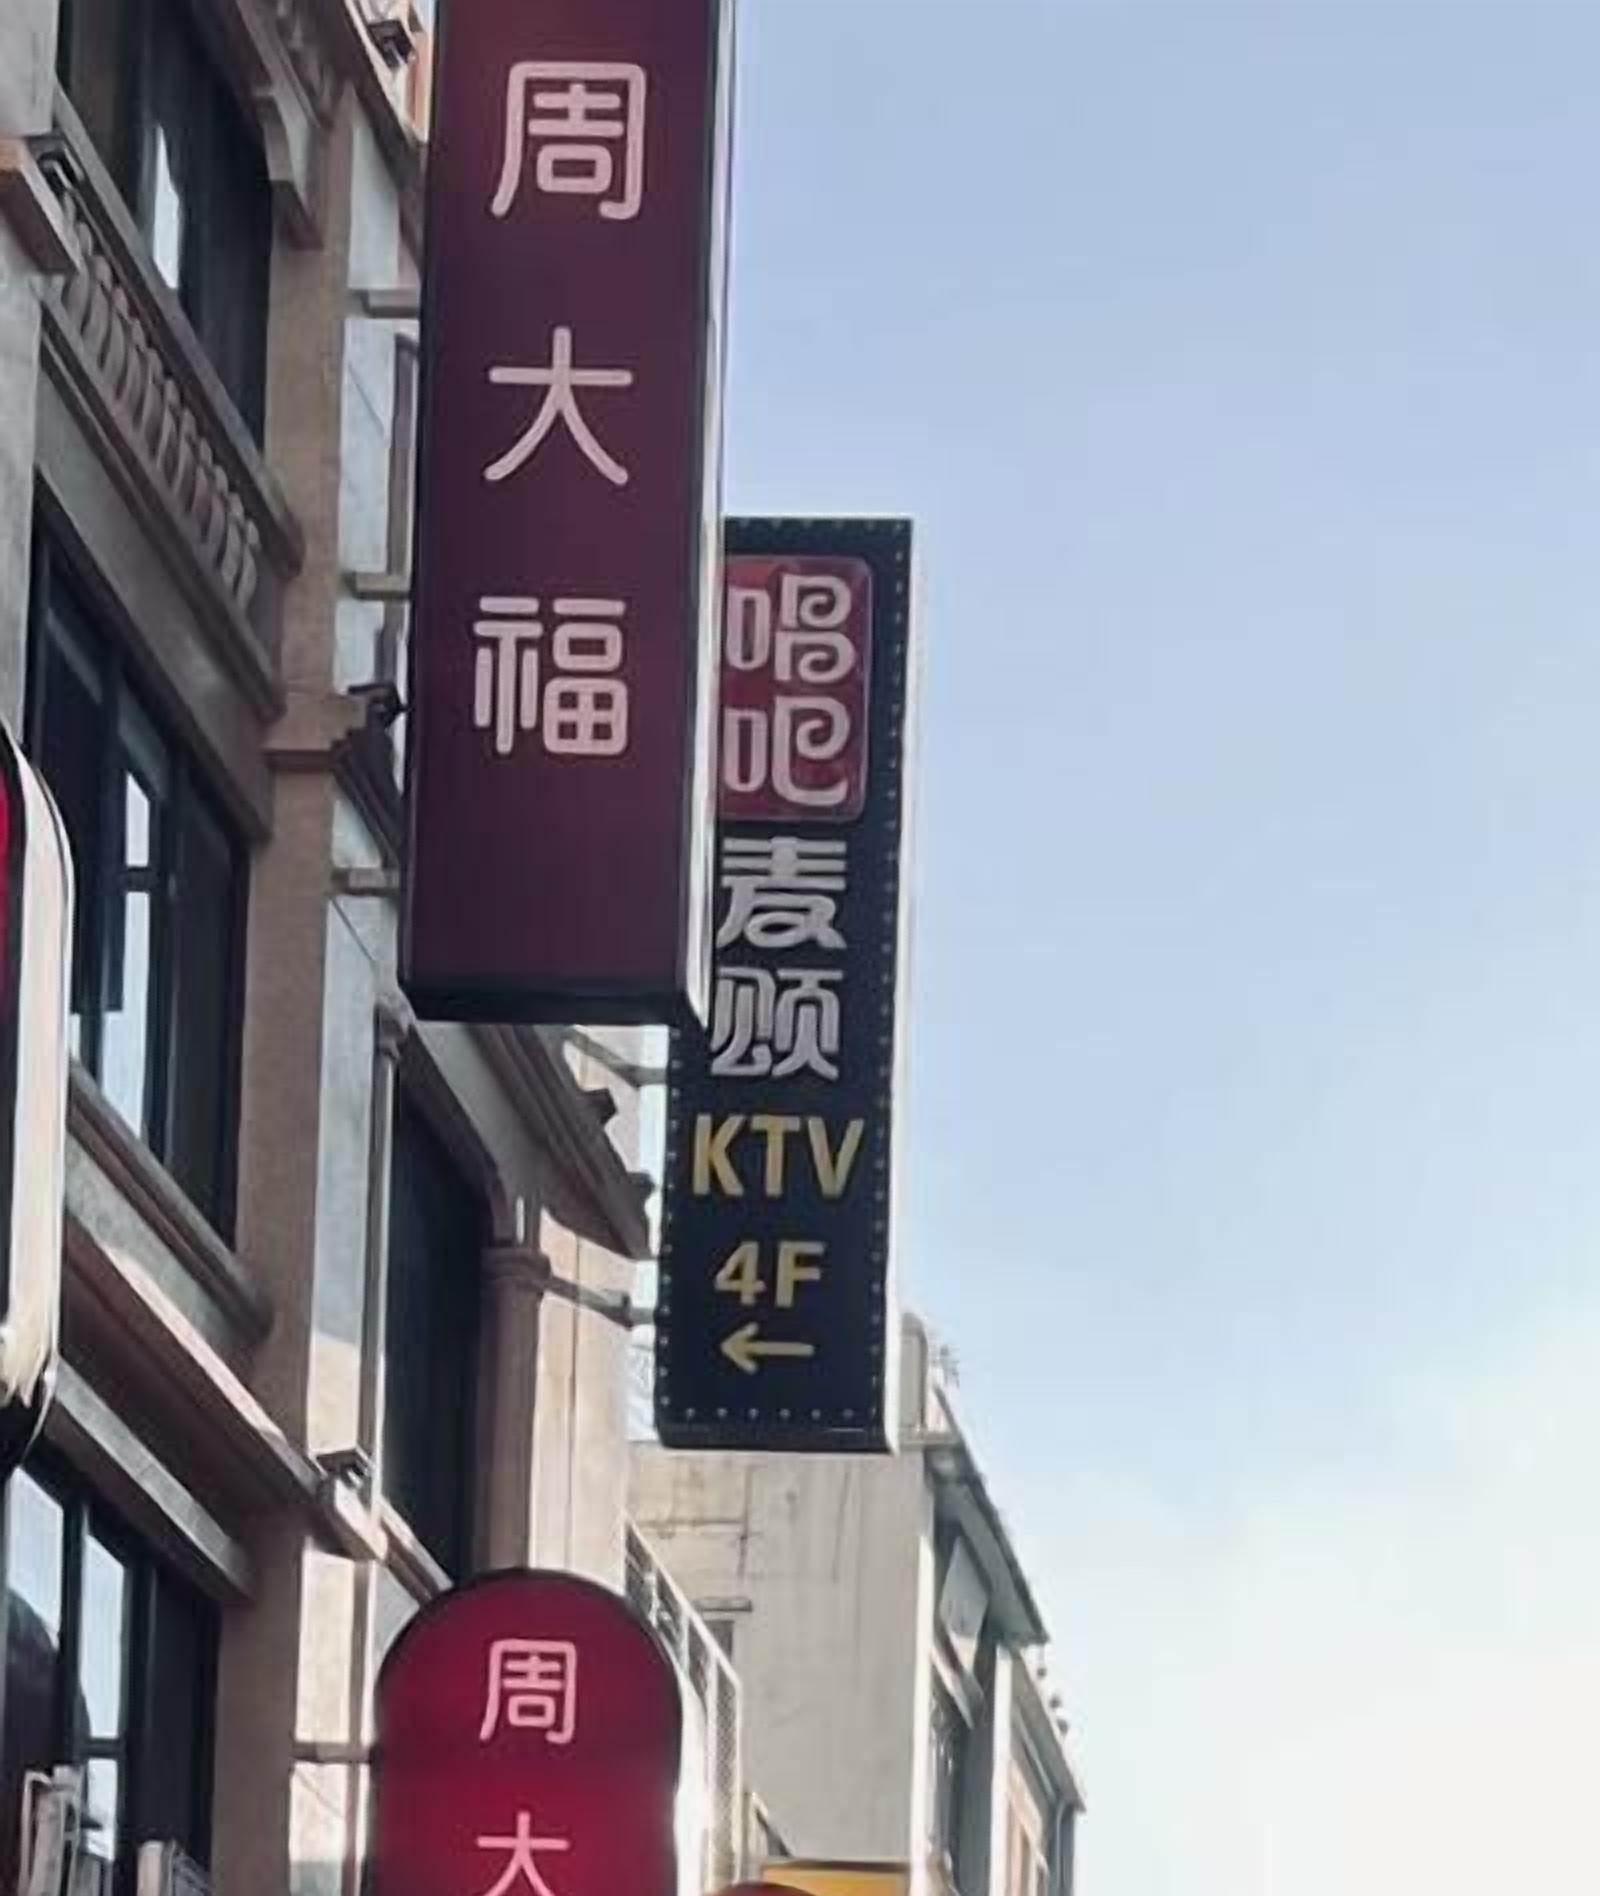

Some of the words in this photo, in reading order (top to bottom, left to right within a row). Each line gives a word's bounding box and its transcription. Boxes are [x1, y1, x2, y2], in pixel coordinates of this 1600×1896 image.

[474, 59, 648, 757] 周大福
[691, 1113, 865, 1198] KTV
[713, 1239, 828, 1310] 4F
